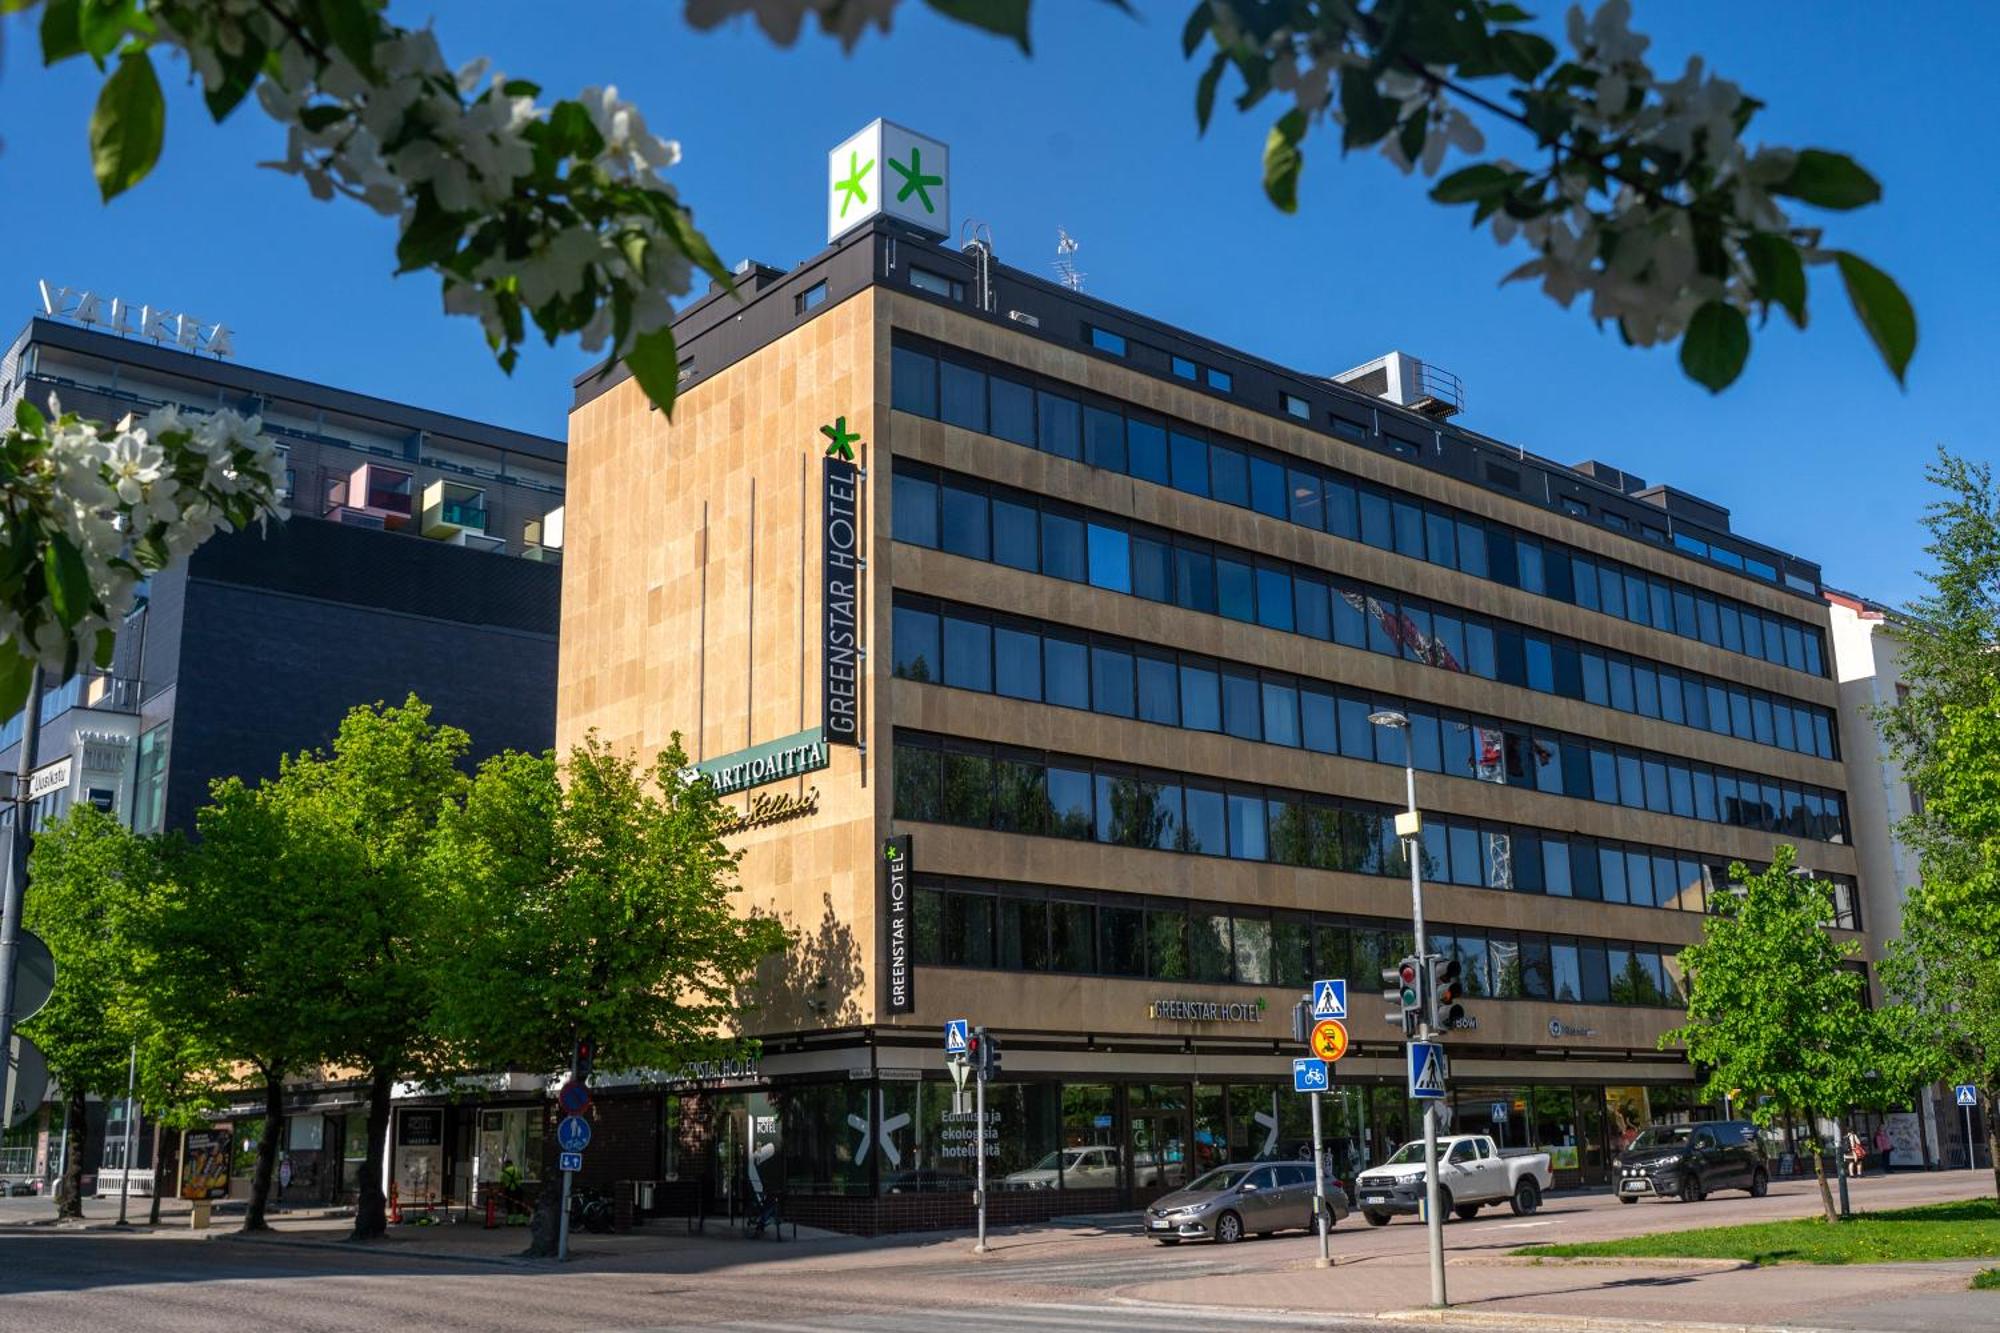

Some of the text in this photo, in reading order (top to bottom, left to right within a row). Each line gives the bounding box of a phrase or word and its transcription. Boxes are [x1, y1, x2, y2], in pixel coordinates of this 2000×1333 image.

[39, 279, 234, 356] VALKEA
[829, 472, 855, 733] GREENSTAR HOTEL
[712, 741, 822, 789] ARTIOAITTA
[891, 852, 905, 1006] GREENSTAR HOTEL
[1154, 1000, 1263, 1022] GREENSTAR HOTEL
[723, 1057, 758, 1077] HOTEL
[942, 1126, 998, 1142] ekologsia
[990, 1109, 1001, 1125] ja
